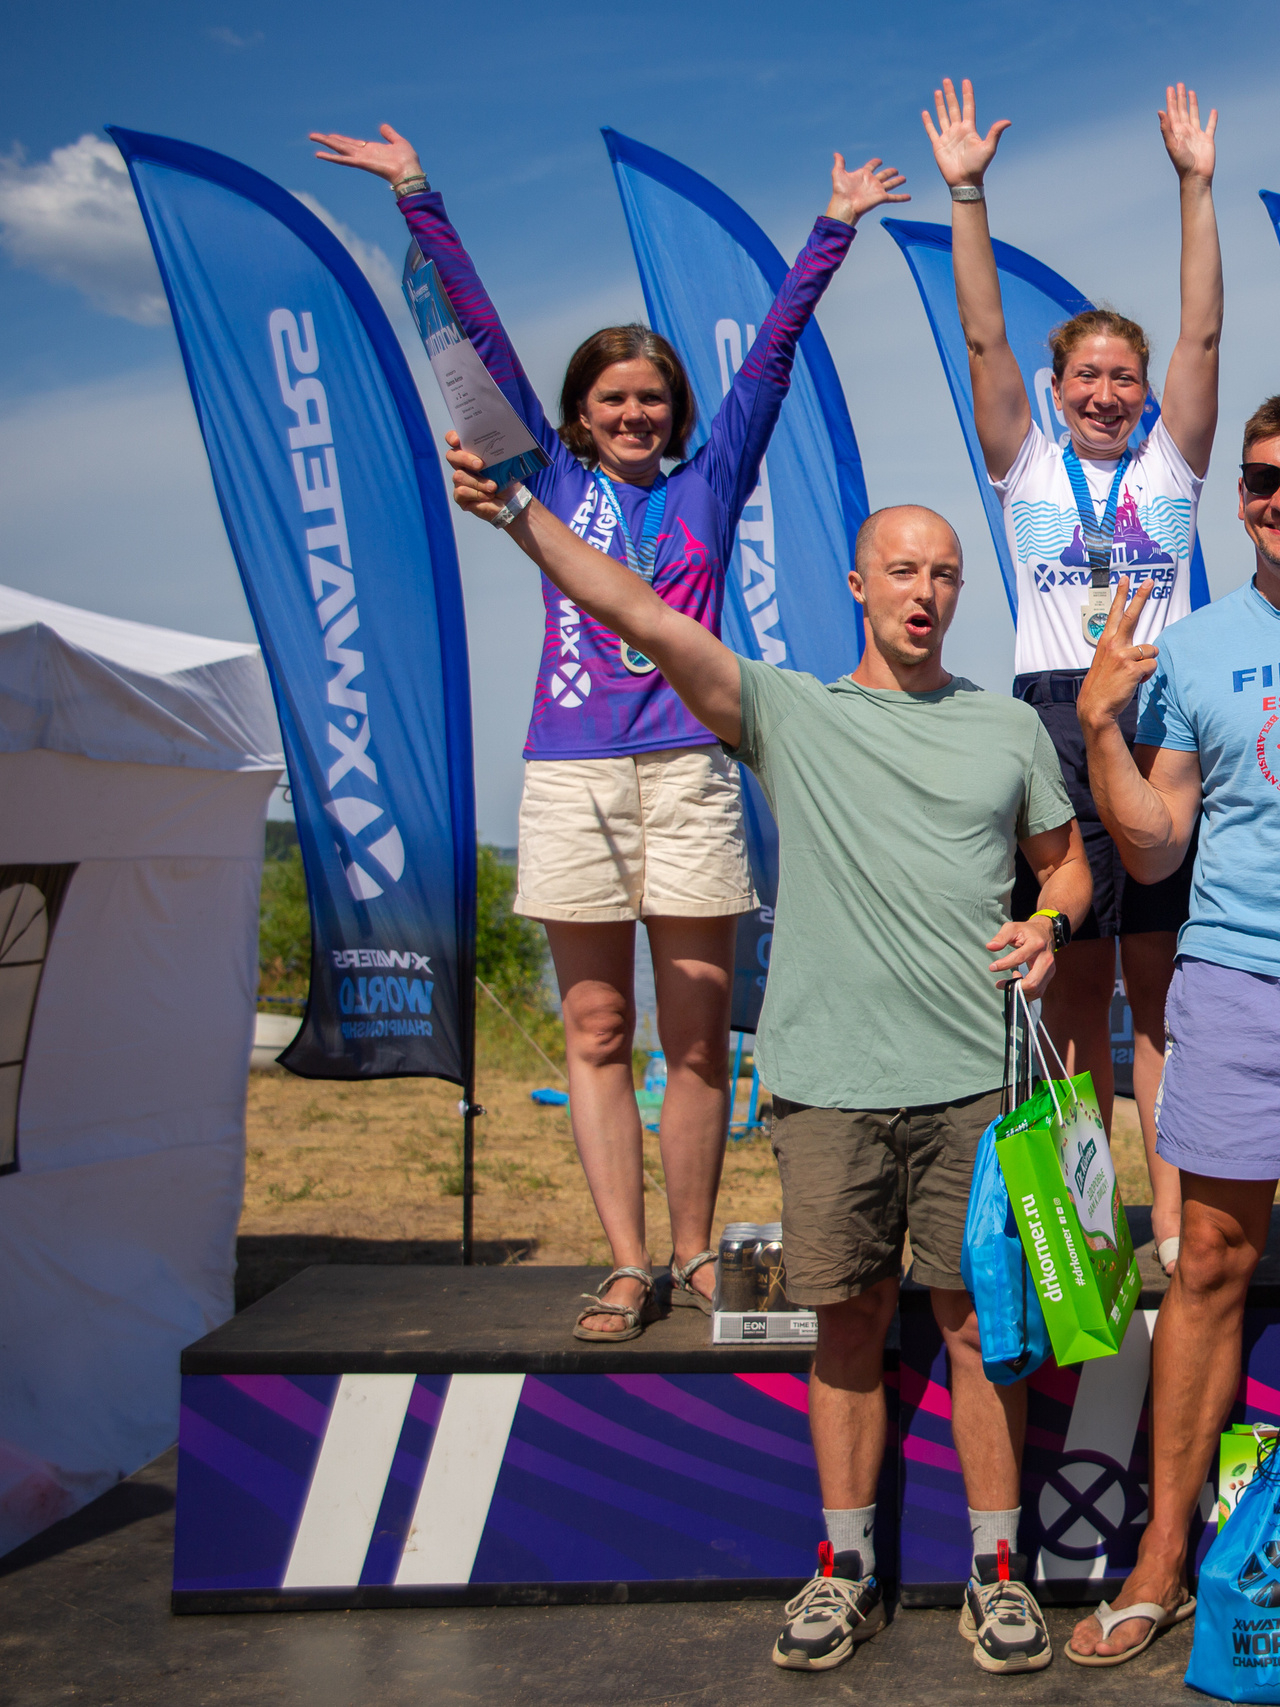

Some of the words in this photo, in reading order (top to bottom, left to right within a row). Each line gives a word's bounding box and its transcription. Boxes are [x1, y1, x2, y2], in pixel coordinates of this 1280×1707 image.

[1021, 1193, 1063, 1302] drkorner.ru
[1061, 1227, 1086, 1287] #drkorner
[793, 1321, 810, 1329] TIME
